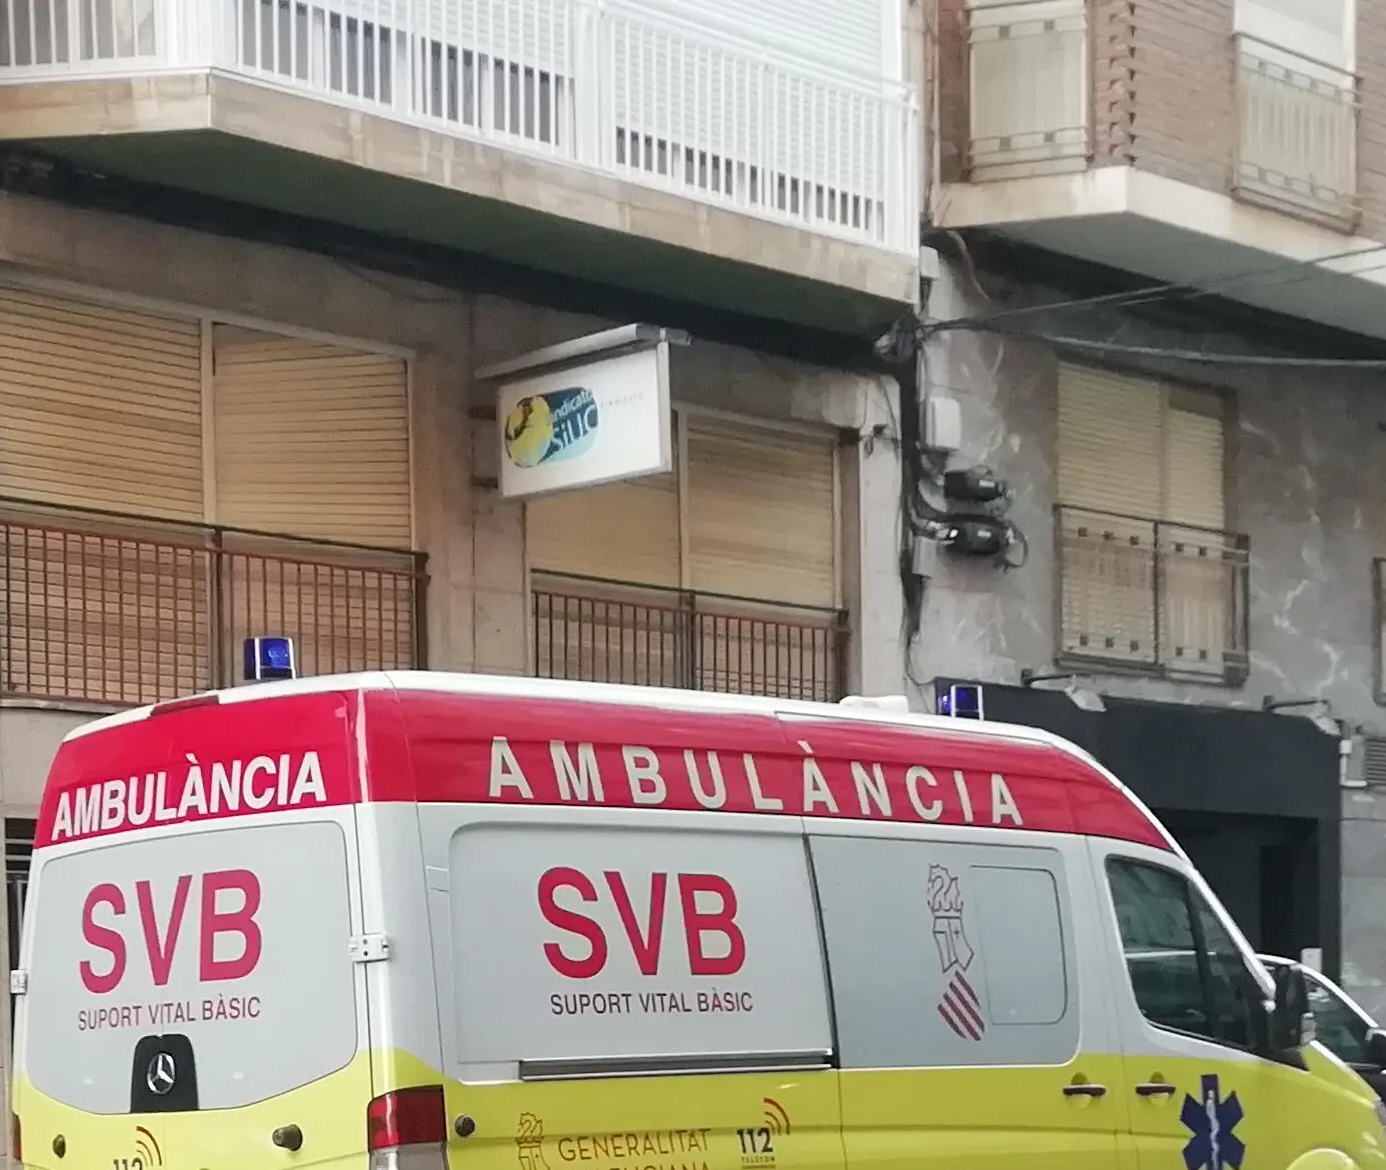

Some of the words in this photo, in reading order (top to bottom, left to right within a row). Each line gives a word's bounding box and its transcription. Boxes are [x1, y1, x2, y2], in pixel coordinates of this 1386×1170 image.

[50, 751, 327, 841] AMBULÀNCIA
[489, 736, 1024, 826] AMBULÀNCIA
[79, 868, 263, 994] SVB
[538, 866, 746, 979] SVB
[78, 1005, 142, 1031] SUPORT
[149, 1001, 196, 1025] VITAL
[202, 993, 262, 1021] BÀSIC
[550, 993, 632, 1015] SUPORT
[638, 992, 693, 1013] VITAL
[697, 987, 754, 1013] BÀSIC
[558, 1128, 712, 1162] GENERALITAT
[736, 1127, 774, 1154] 112
